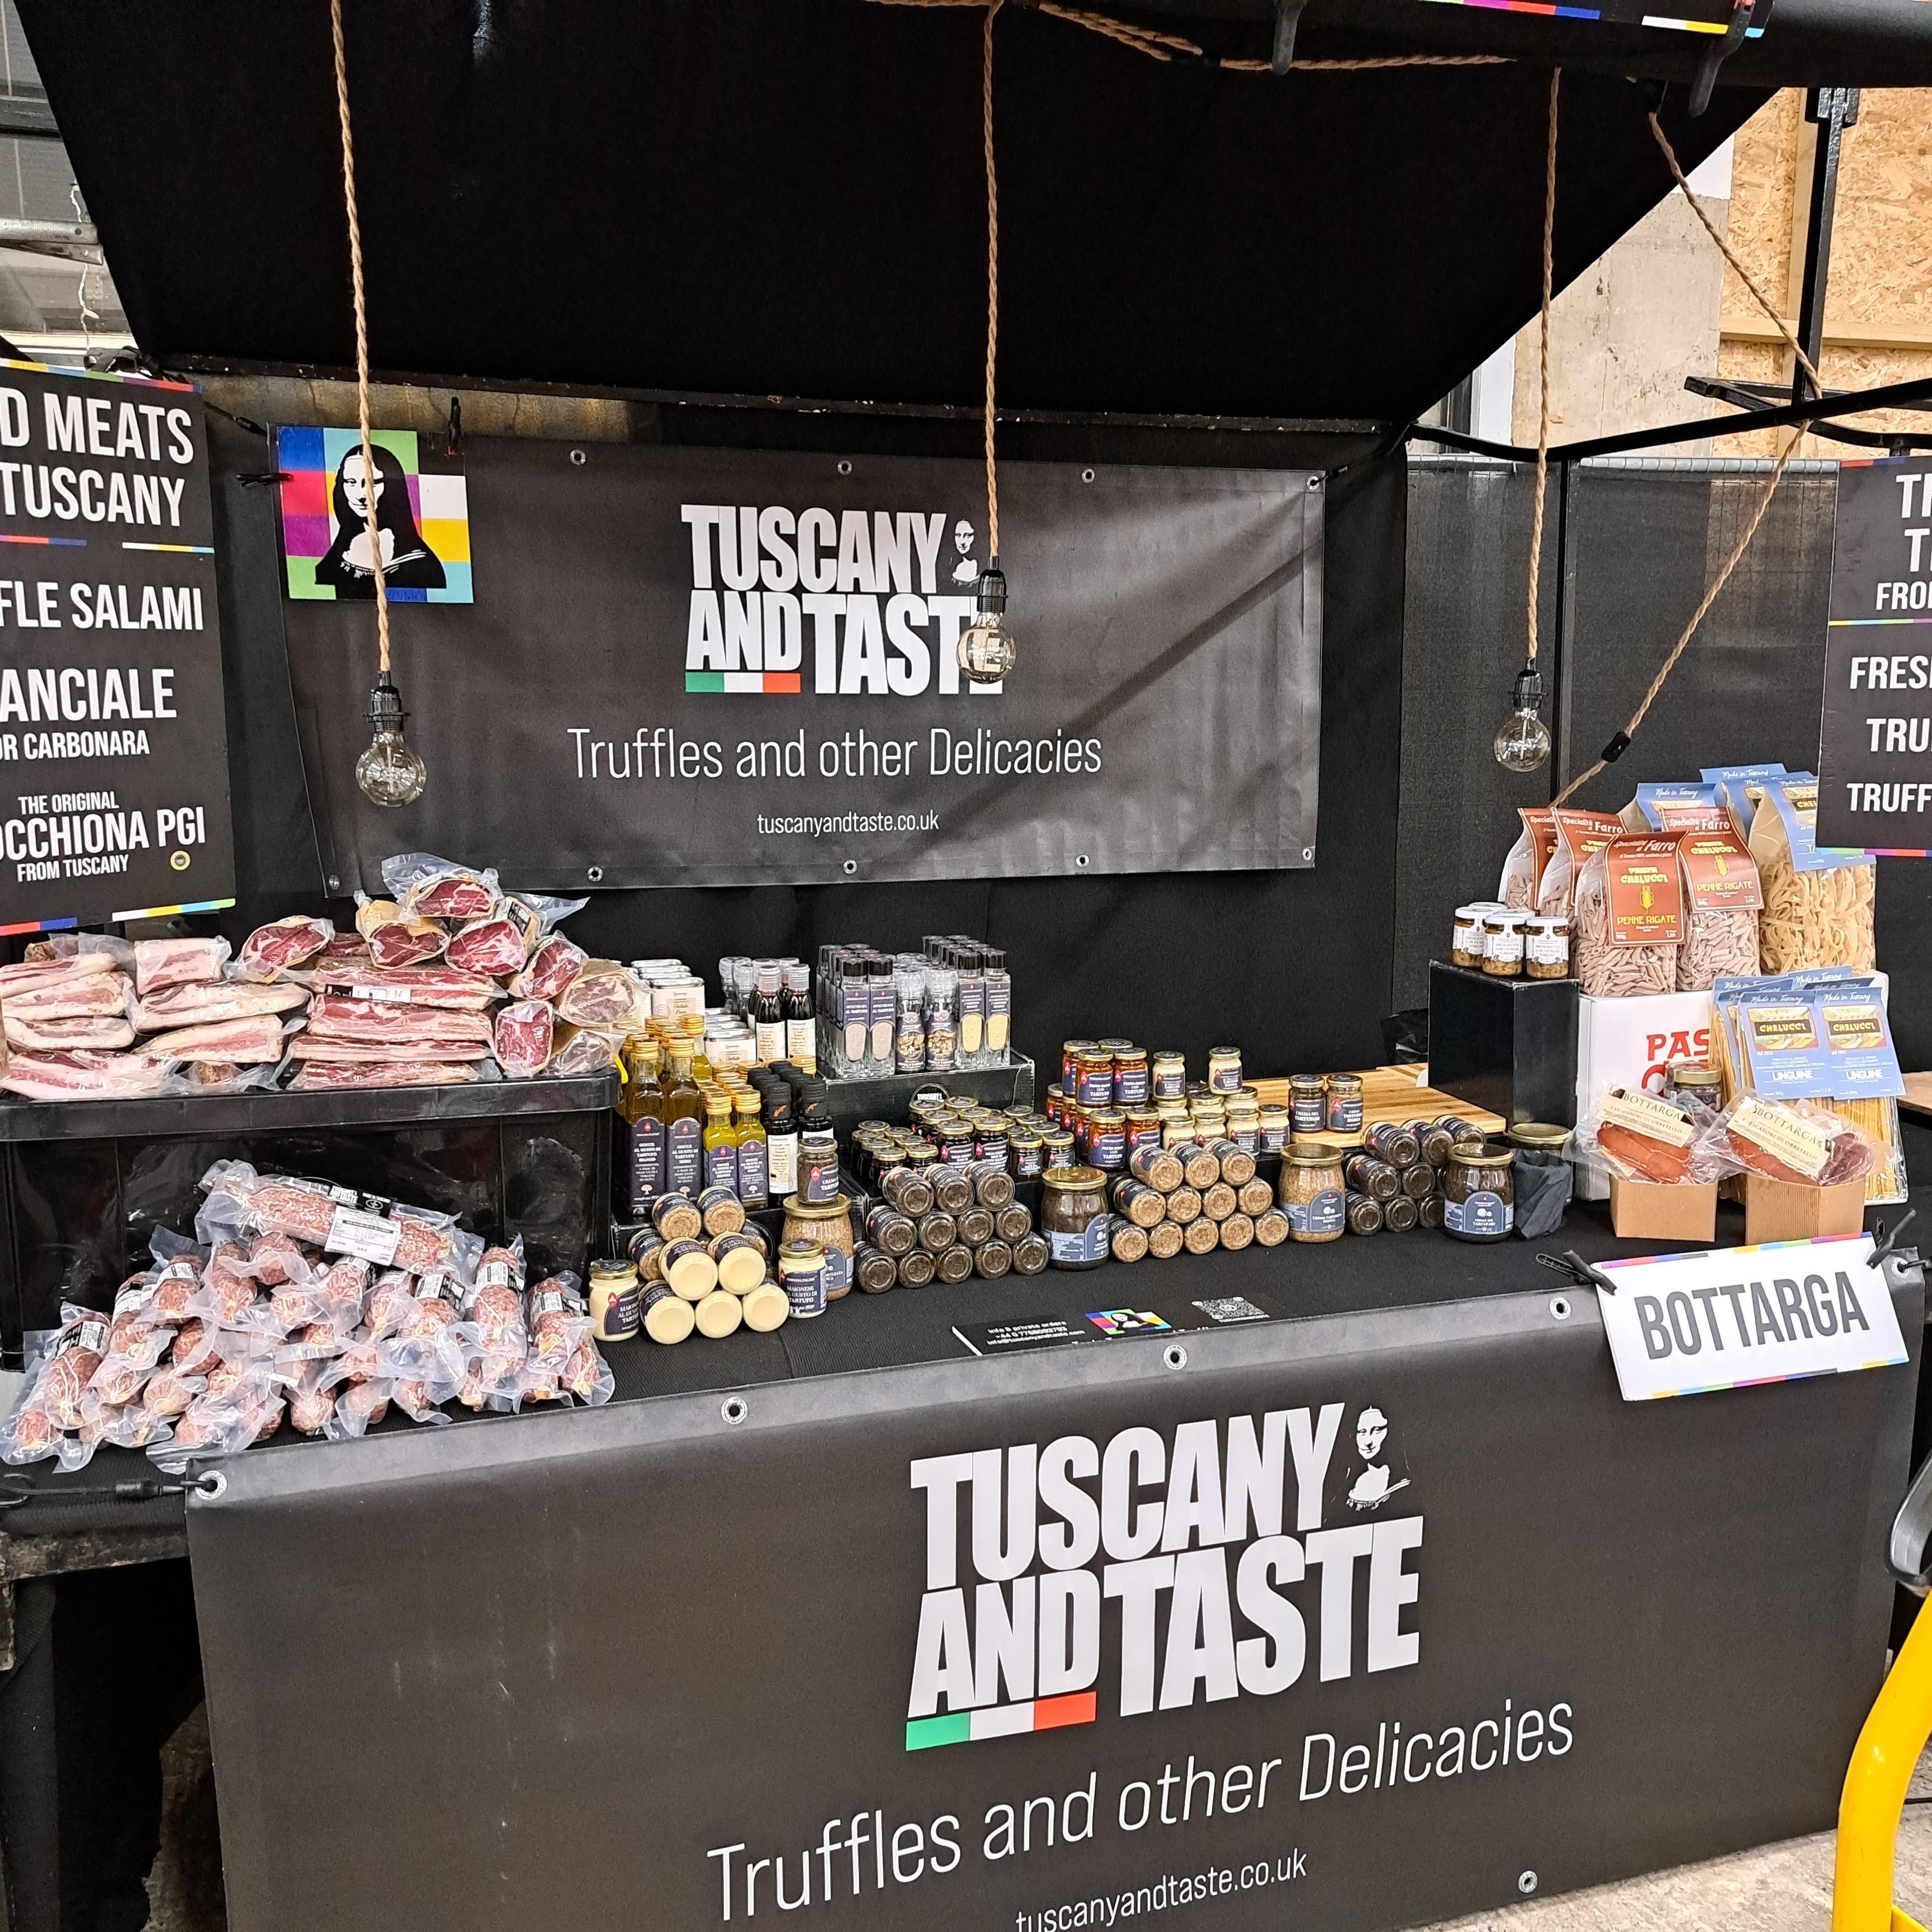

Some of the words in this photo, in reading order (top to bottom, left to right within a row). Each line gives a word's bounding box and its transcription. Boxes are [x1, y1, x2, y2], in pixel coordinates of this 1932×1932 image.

[44, 392, 194, 465] MEATS
[0, 461, 185, 527] TUSCANY
[681, 504, 947, 594] TUSCANY
[70, 583, 204, 631] SALAMI
[1849, 655, 1932, 690] FRES
[23, 730, 150, 760] CARBONARA
[1865, 717, 1932, 753] TRU
[567, 727, 723, 779] Truffles
[736, 729, 805, 778] and
[818, 728, 918, 778] other
[929, 728, 1102, 777] Delicacies
[18, 794, 49, 816] THE
[51, 791, 120, 812] ORIGINAL
[157, 806, 206, 847] PGI
[757, 810, 939, 838] tuscanyandtaste.co.uk
[1594, 821, 1623, 834] Farro
[1701, 818, 1730, 831] Farro
[1644, 840, 1677, 851] Farro
[17, 860, 60, 883] FROM
[63, 854, 129, 878] TUSCANY
[1696, 882, 1723, 892] PENNE
[1724, 880, 1754, 891] RIGATE
[1617, 915, 1645, 926] PENNE
[1646, 915, 1677, 925] RIGATE
[1759, 1022, 1807, 1033] CHELUCCI
[1832, 1021, 1876, 1032] CHELUCCI
[1772, 1069, 1813, 1081] LINGUINE
[1845, 1068, 1883, 1081] LINGUINE
[1622, 1092, 1682, 1120] BOTTARGA
[1746, 1119, 1776, 1139] ESCATORI
[1756, 1106, 1816, 1145] BOTTARGA
[1634, 1271, 1871, 1360] BOTTARGA
[910, 1402, 1345, 1590] TUSCANY
[707, 1809, 962, 1922] Truffles
[983, 1771, 1097, 1860] and
[1118, 1756, 1283, 1832] other
[1299, 1698, 1575, 1801] Delicacies
[1015, 1847, 1308, 1932] tuscanyandtaste.co.uk
